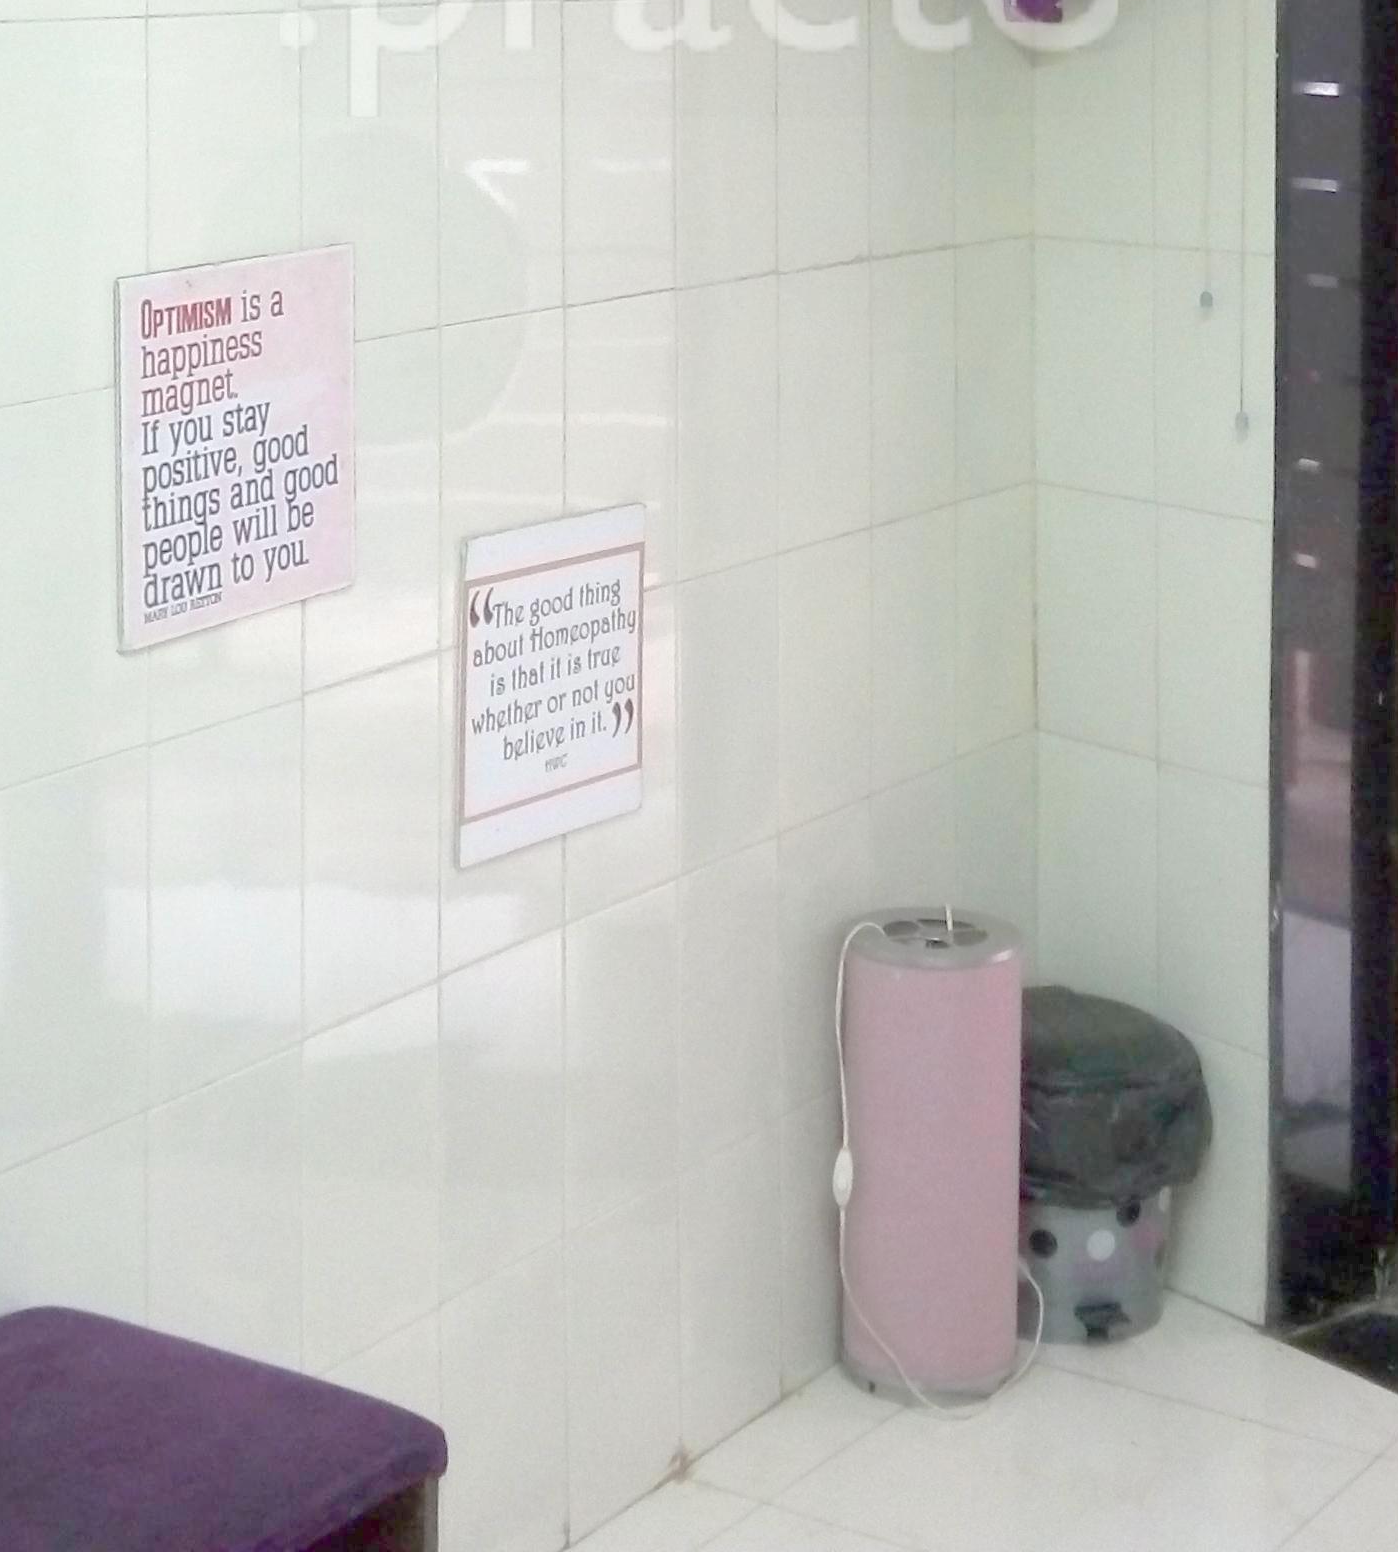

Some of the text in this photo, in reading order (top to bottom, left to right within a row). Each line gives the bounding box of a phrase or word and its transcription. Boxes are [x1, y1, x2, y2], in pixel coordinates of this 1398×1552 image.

[241, 291, 262, 324] is
[270, 290, 285, 317] a
[141, 329, 263, 380] happiness
[141, 368, 239, 418] magnet.
[141, 400, 271, 458] If you stay
[143, 424, 310, 501] positive, good
[143, 453, 340, 533] things and good
[142, 499, 315, 579] people will be
[144, 539, 311, 610] drawn to you.
[529, 592, 575, 628] good
[579, 578, 622, 612] thing
[472, 606, 637, 668] about Homeopathy
[489, 644, 622, 698] is that it is true
[471, 672, 636, 737] whether or not you
[503, 724, 566, 761] believe
[570, 717, 586, 741] in
